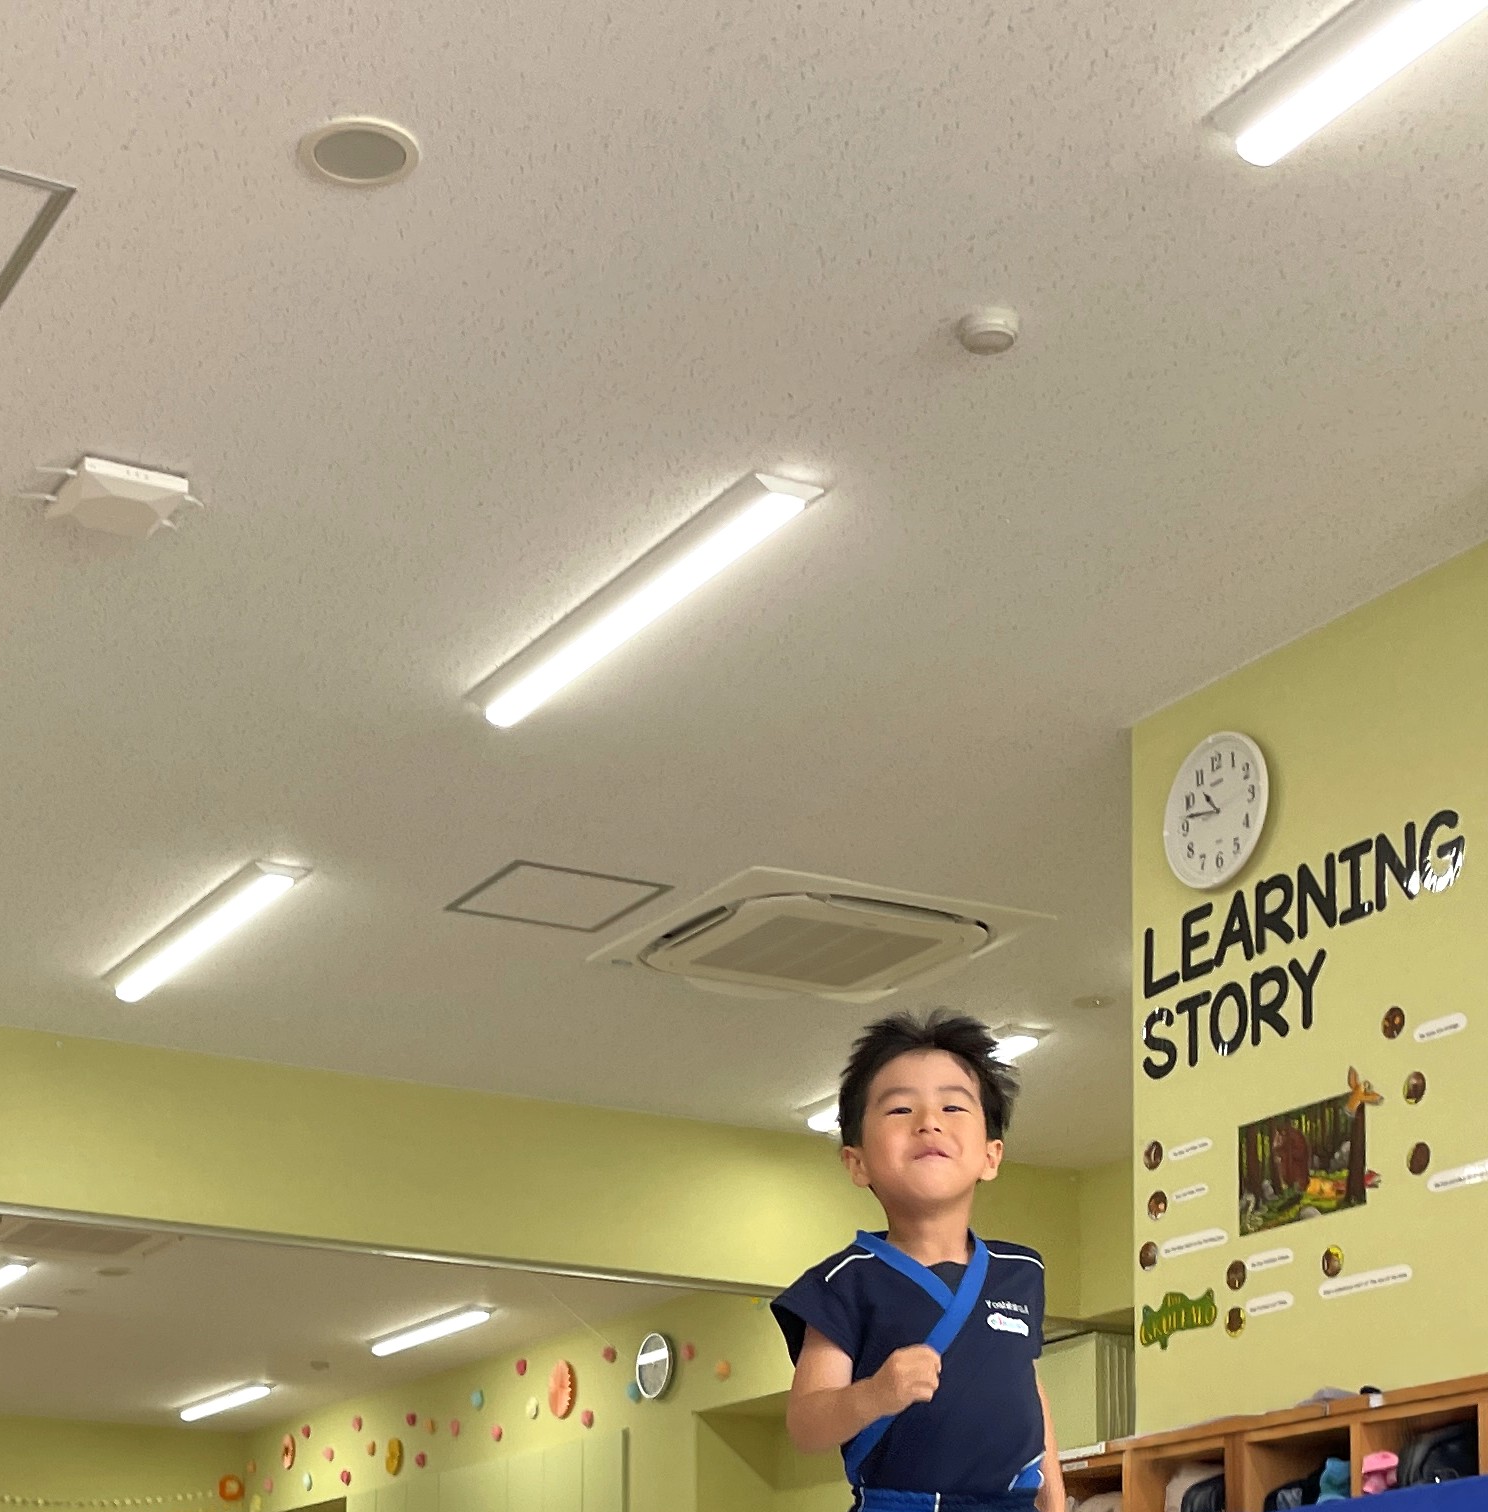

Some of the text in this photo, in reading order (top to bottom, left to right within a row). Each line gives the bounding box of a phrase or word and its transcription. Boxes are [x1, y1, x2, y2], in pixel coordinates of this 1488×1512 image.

[1211, 752, 1222, 772] 12
[1230, 752, 1235, 768] 1
[1195, 769, 1204, 787] 11
[1242, 762, 1250, 780] 2
[1185, 791, 1195, 811] 10
[1248, 784, 1255, 803] 3
[1182, 820, 1190, 837] 9
[1242, 812, 1250, 829] 4
[1187, 842, 1194, 859] 8
[1232, 837, 1240, 855] 5
[1199, 854, 1206, 870] 7
[1215, 851, 1223, 869] 6
[1144, 809, 1465, 999] LEARNING
[1142, 948, 1327, 1080] STORY
